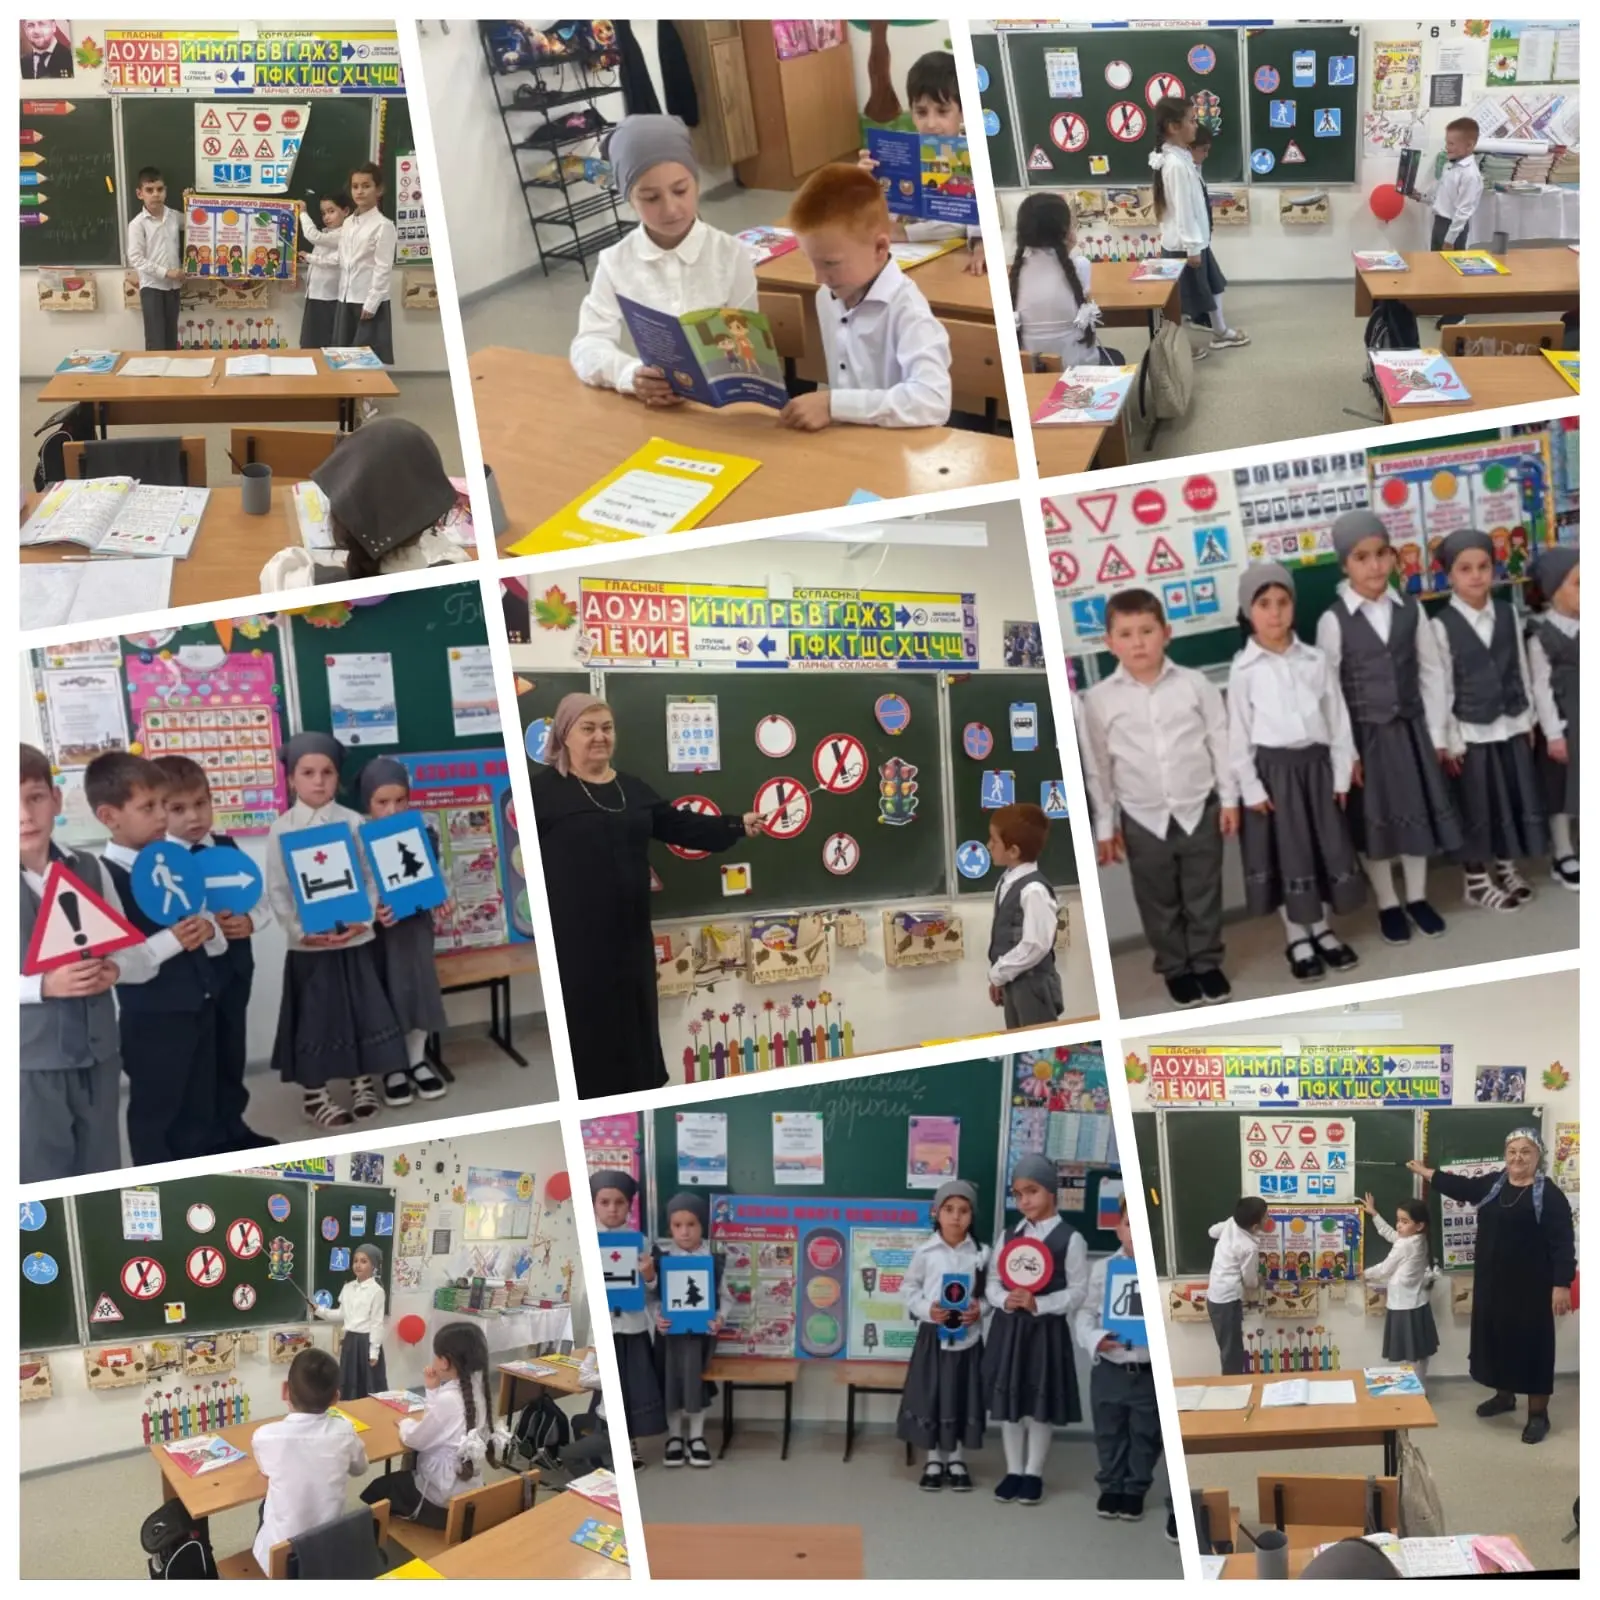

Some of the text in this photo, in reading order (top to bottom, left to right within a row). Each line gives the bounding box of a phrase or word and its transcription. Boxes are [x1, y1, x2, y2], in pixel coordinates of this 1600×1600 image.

[1416, 22, 1422, 30] 7
[121, 31, 164, 39] ГЛАСНЫЕ
[1430, 26, 1440, 38] 6
[1432, 372, 1460, 390] 2
[1095, 391, 1120, 410] 2
[1186, 487, 1214, 500] STOP
[604, 581, 665, 593] ГЛАСНЫЕ
[792, 589, 860, 600] СОГЛАСНЫЕ
[797, 661, 889, 670] ПАРНЫЕ СОГЛАСНЫЕ
[753, 964, 828, 980] МАТЕМАТИКА
[415, 1160, 422, 1170] 9
[455, 1164, 460, 1173] 3
